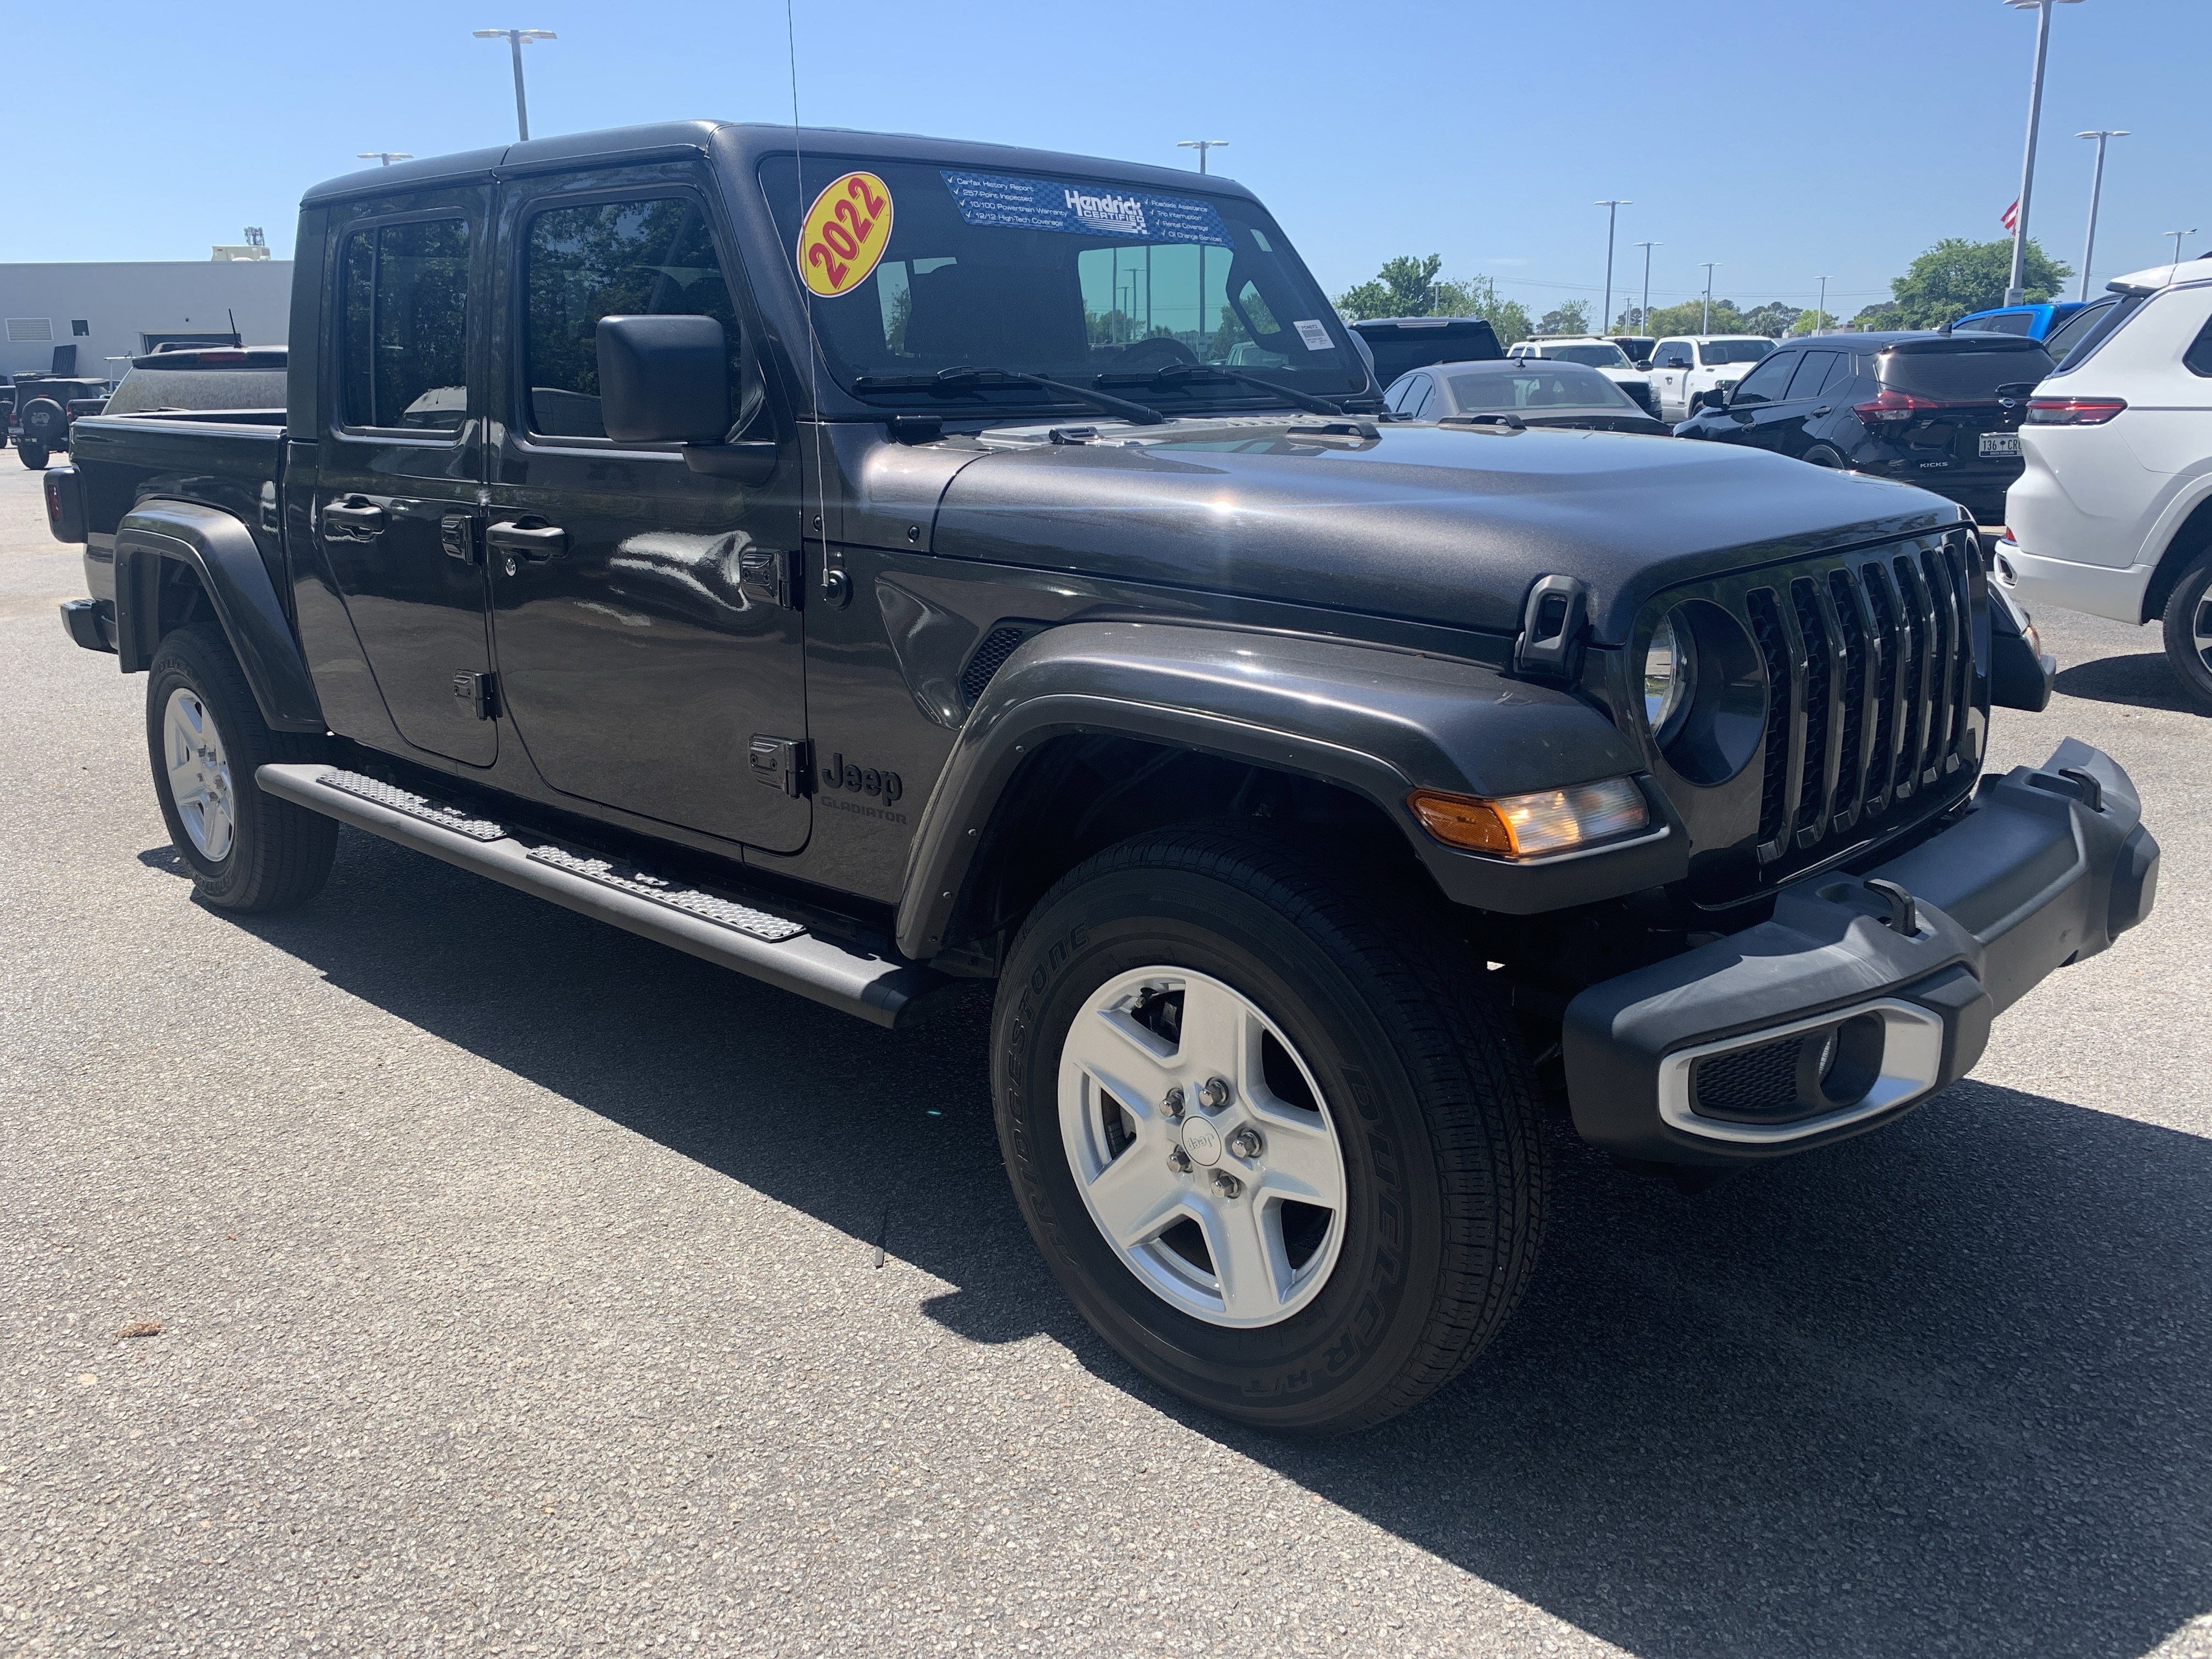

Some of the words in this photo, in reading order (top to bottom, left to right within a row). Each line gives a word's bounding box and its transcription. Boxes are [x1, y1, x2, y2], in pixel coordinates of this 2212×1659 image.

[957, 178, 981, 187] Carfax
[983, 181, 1008, 190] History
[1009, 184, 1034, 192] Report
[963, 189, 998, 199] 257-Point
[997, 204, 1035, 213] Powertrain
[1064, 189, 1143, 217] Hendrick
[1152, 200, 1177, 208] Roadside
[1178, 204, 1208, 212] Assistance
[998, 215, 1030, 223] High-Tech
[1083, 210, 1145, 223] CERTIFIED
[1169, 212, 1202, 221] Interruption
[808, 177, 887, 290] 2022
[1182, 223, 1209, 232] Coverage
[1177, 232, 1198, 240] Change
[1199, 234, 1223, 242] Services
[1983, 439, 1997, 450] 136
[822, 752, 903, 807] Jeep
[820, 795, 907, 824] GLADIATOR
[1187, 1133, 1215, 1150] Jeep
[1321, 1062, 1404, 1378] DUELER
